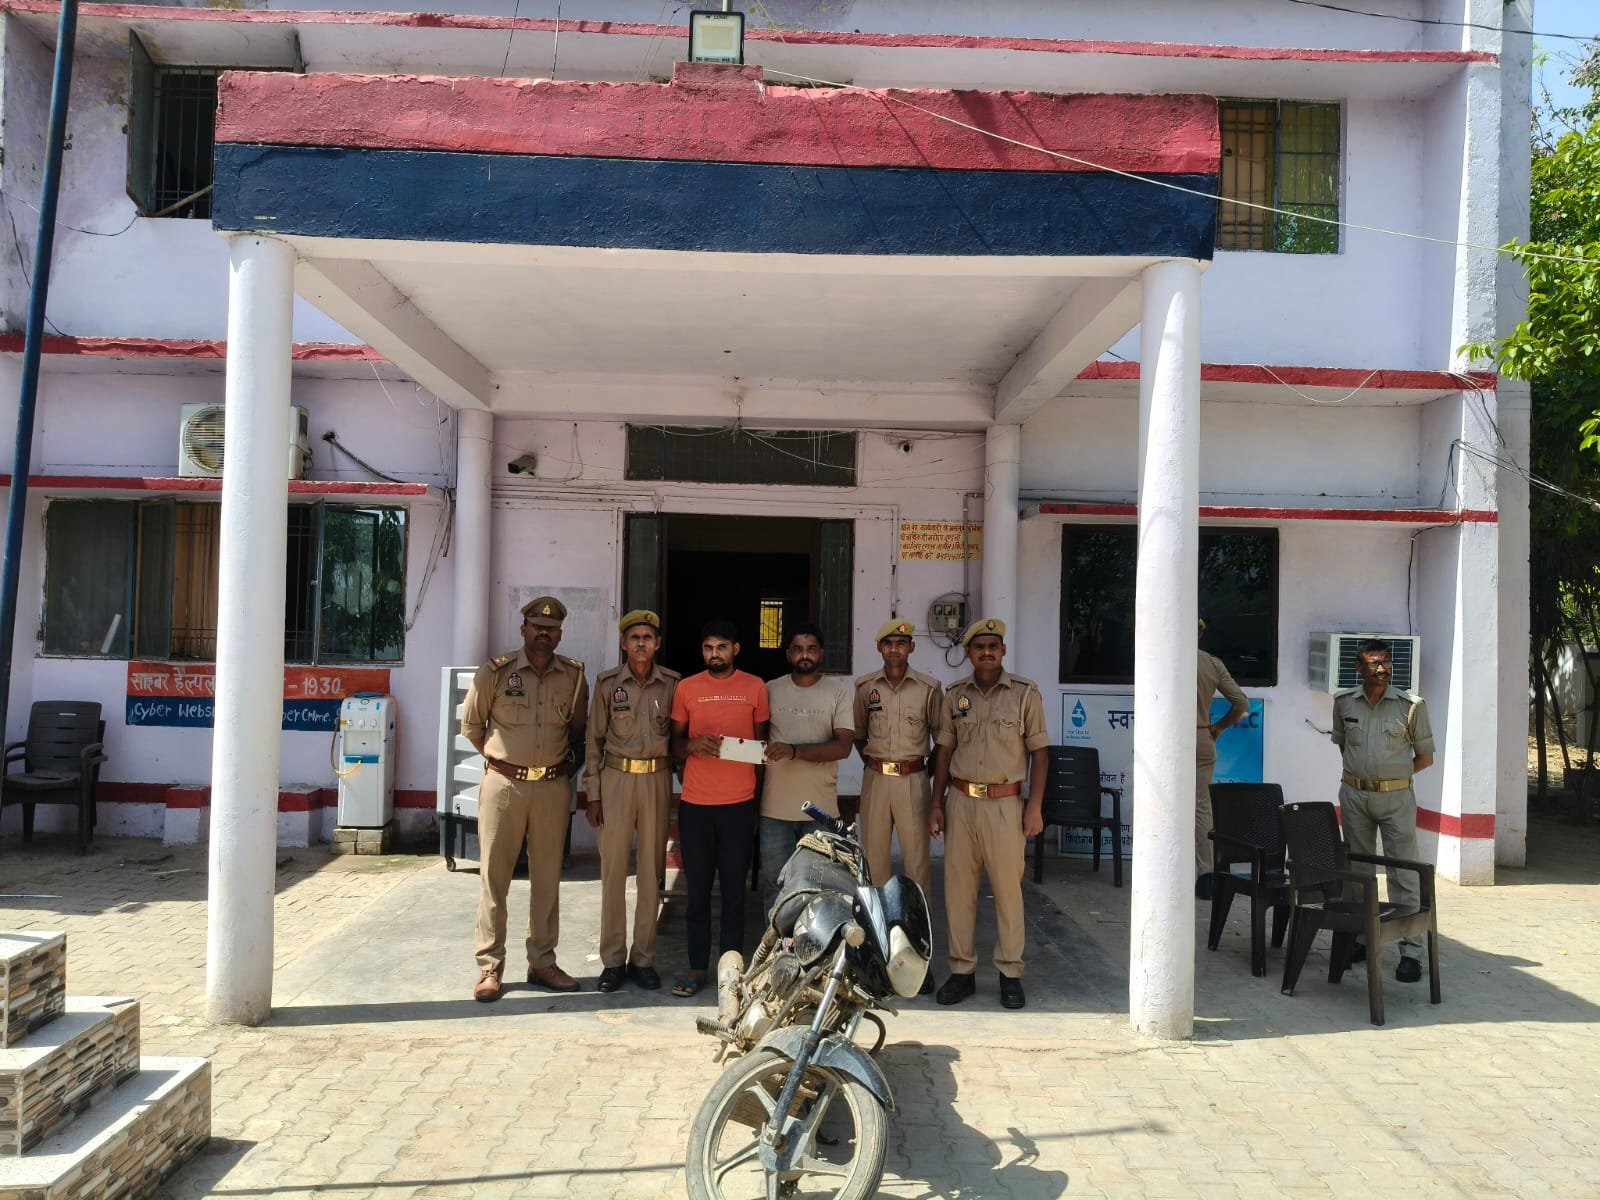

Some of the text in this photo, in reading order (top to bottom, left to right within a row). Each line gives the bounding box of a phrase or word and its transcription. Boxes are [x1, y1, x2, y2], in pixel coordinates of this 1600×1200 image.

[302, 676, 341, 697] 1930
[133, 702, 172, 720] Cyber
[178, 703, 215, 718] Webs
[1107, 710, 1135, 730] स्व
